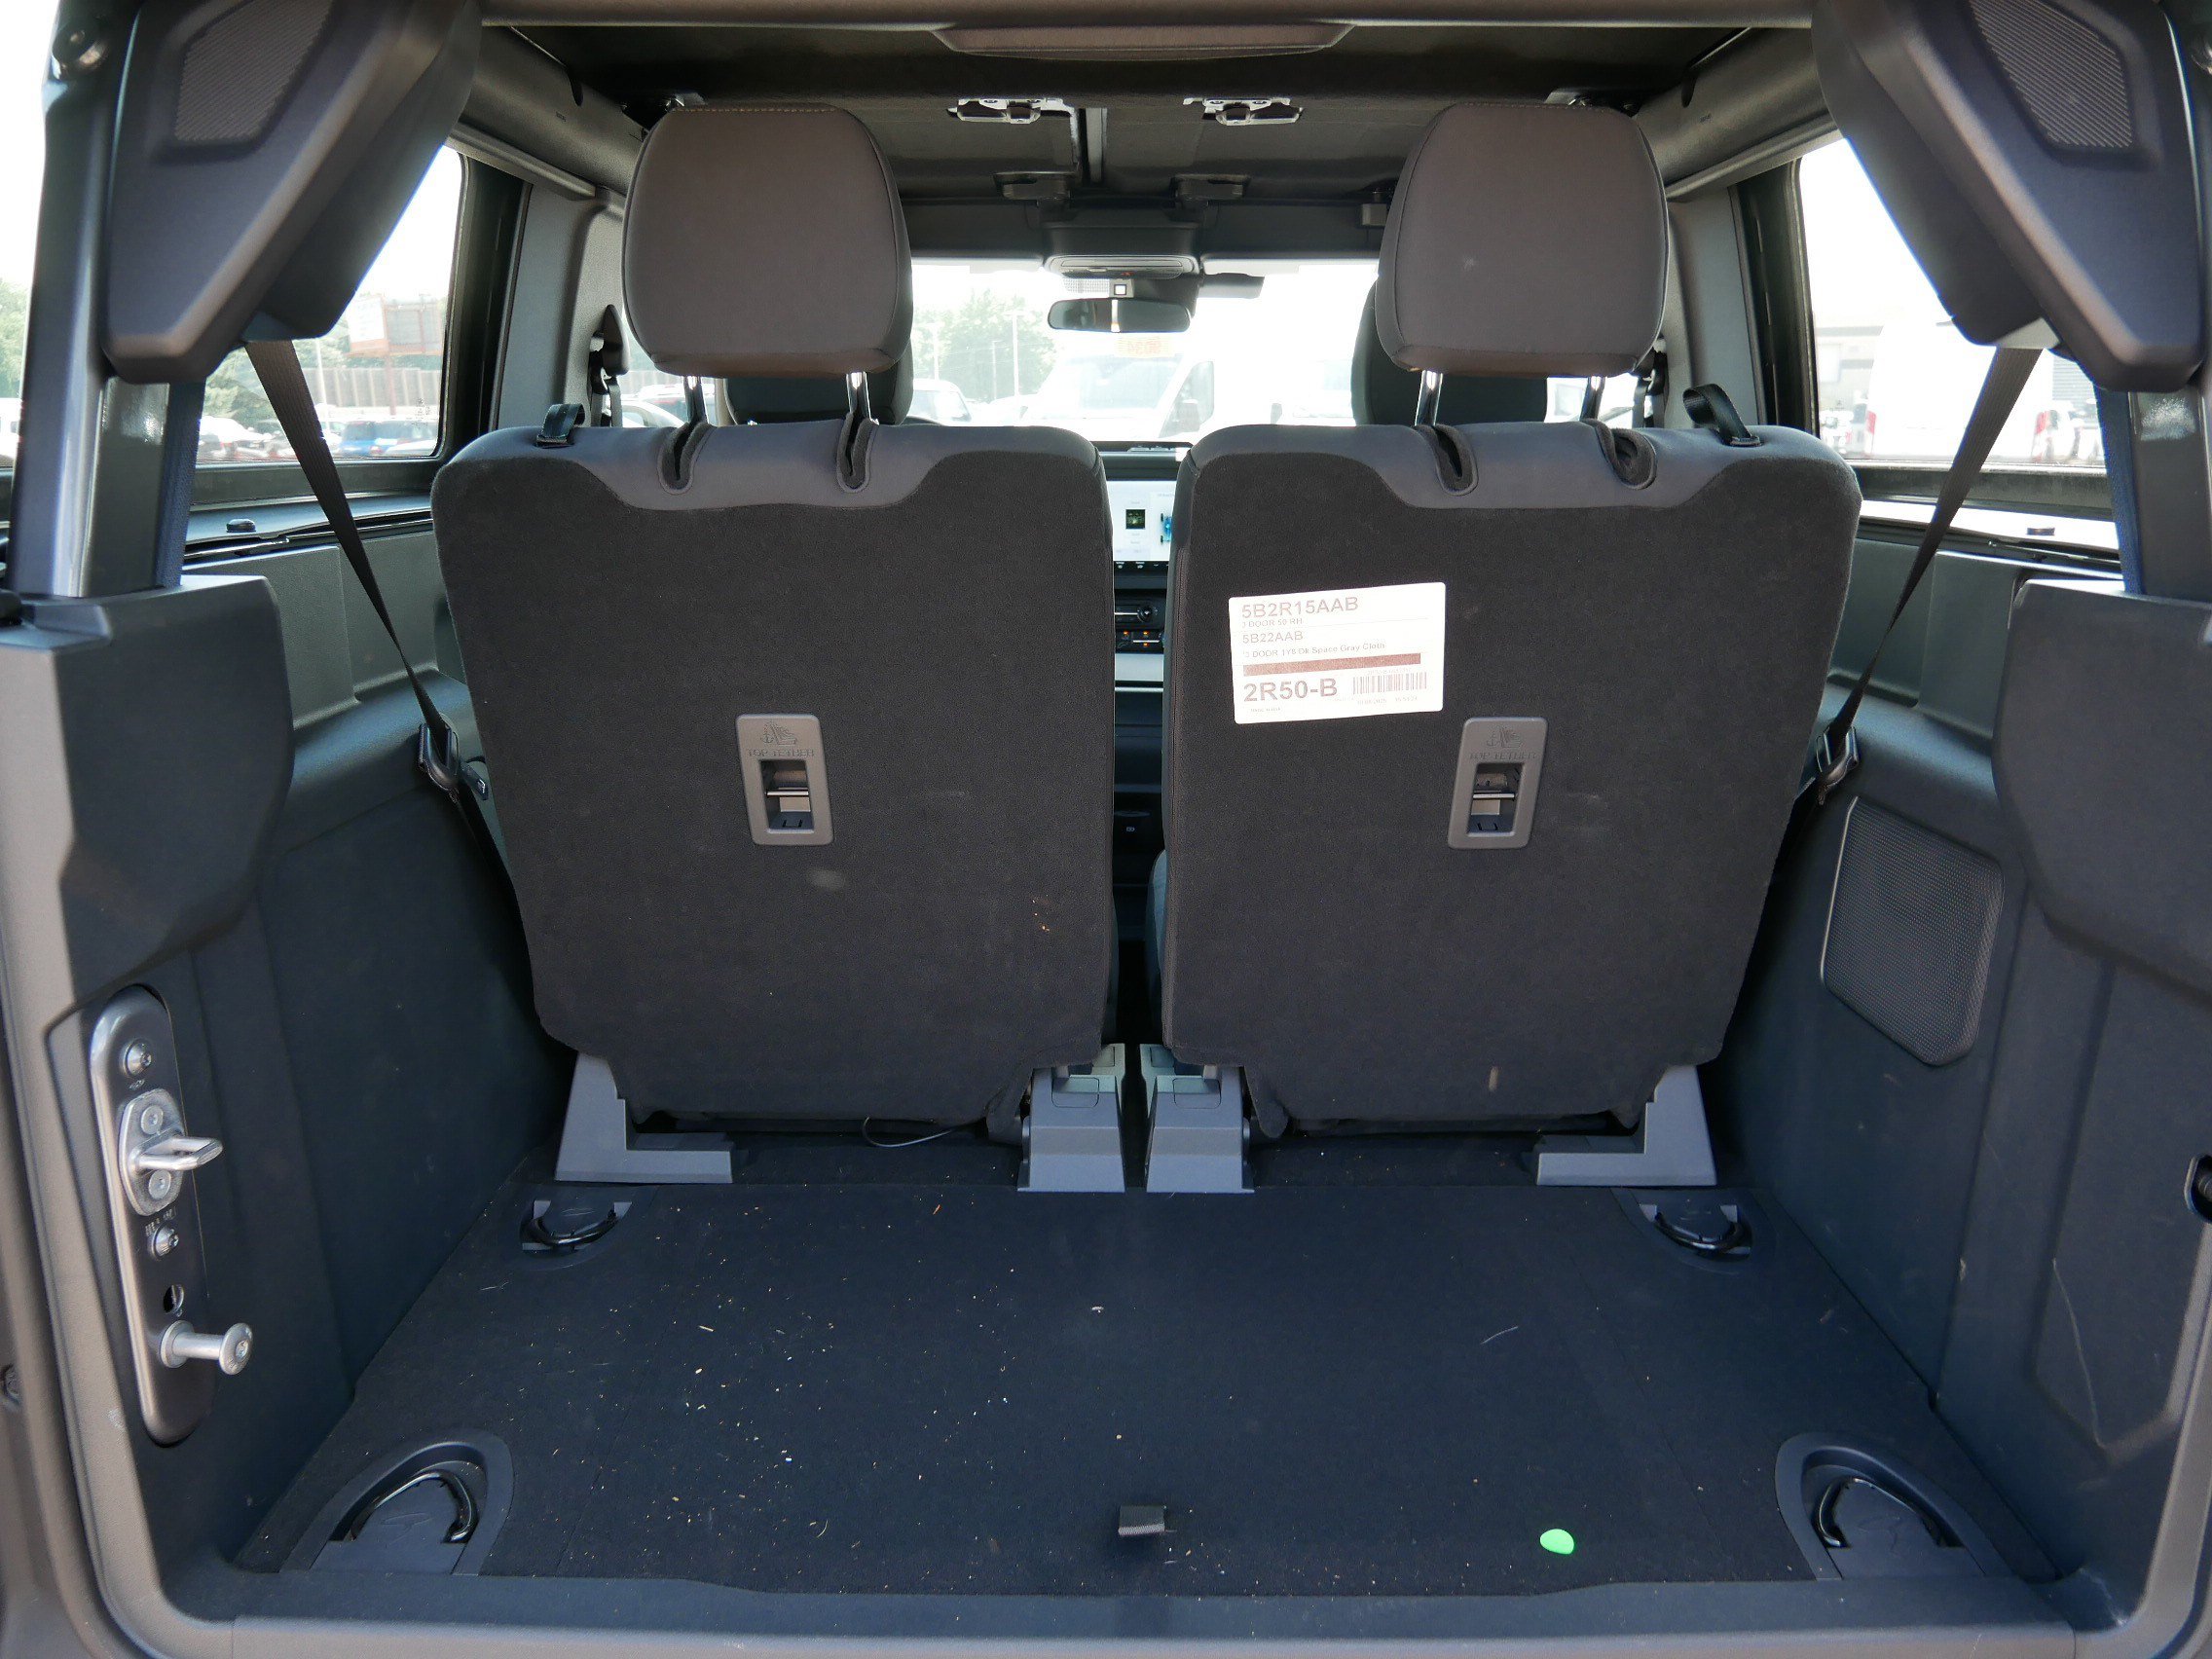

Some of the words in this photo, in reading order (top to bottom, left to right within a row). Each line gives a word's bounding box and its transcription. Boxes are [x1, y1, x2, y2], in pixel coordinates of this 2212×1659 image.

[1241, 597, 1359, 618] 5B2R15AAB
[1242, 630, 1304, 644] 5B22AAB
[1252, 649, 1278, 658] DOOR
[1311, 645, 1338, 655] Space
[1340, 645, 1361, 653] Gray
[1363, 642, 1384, 650] Cloth
[1243, 678, 1338, 702] 2R50-B
